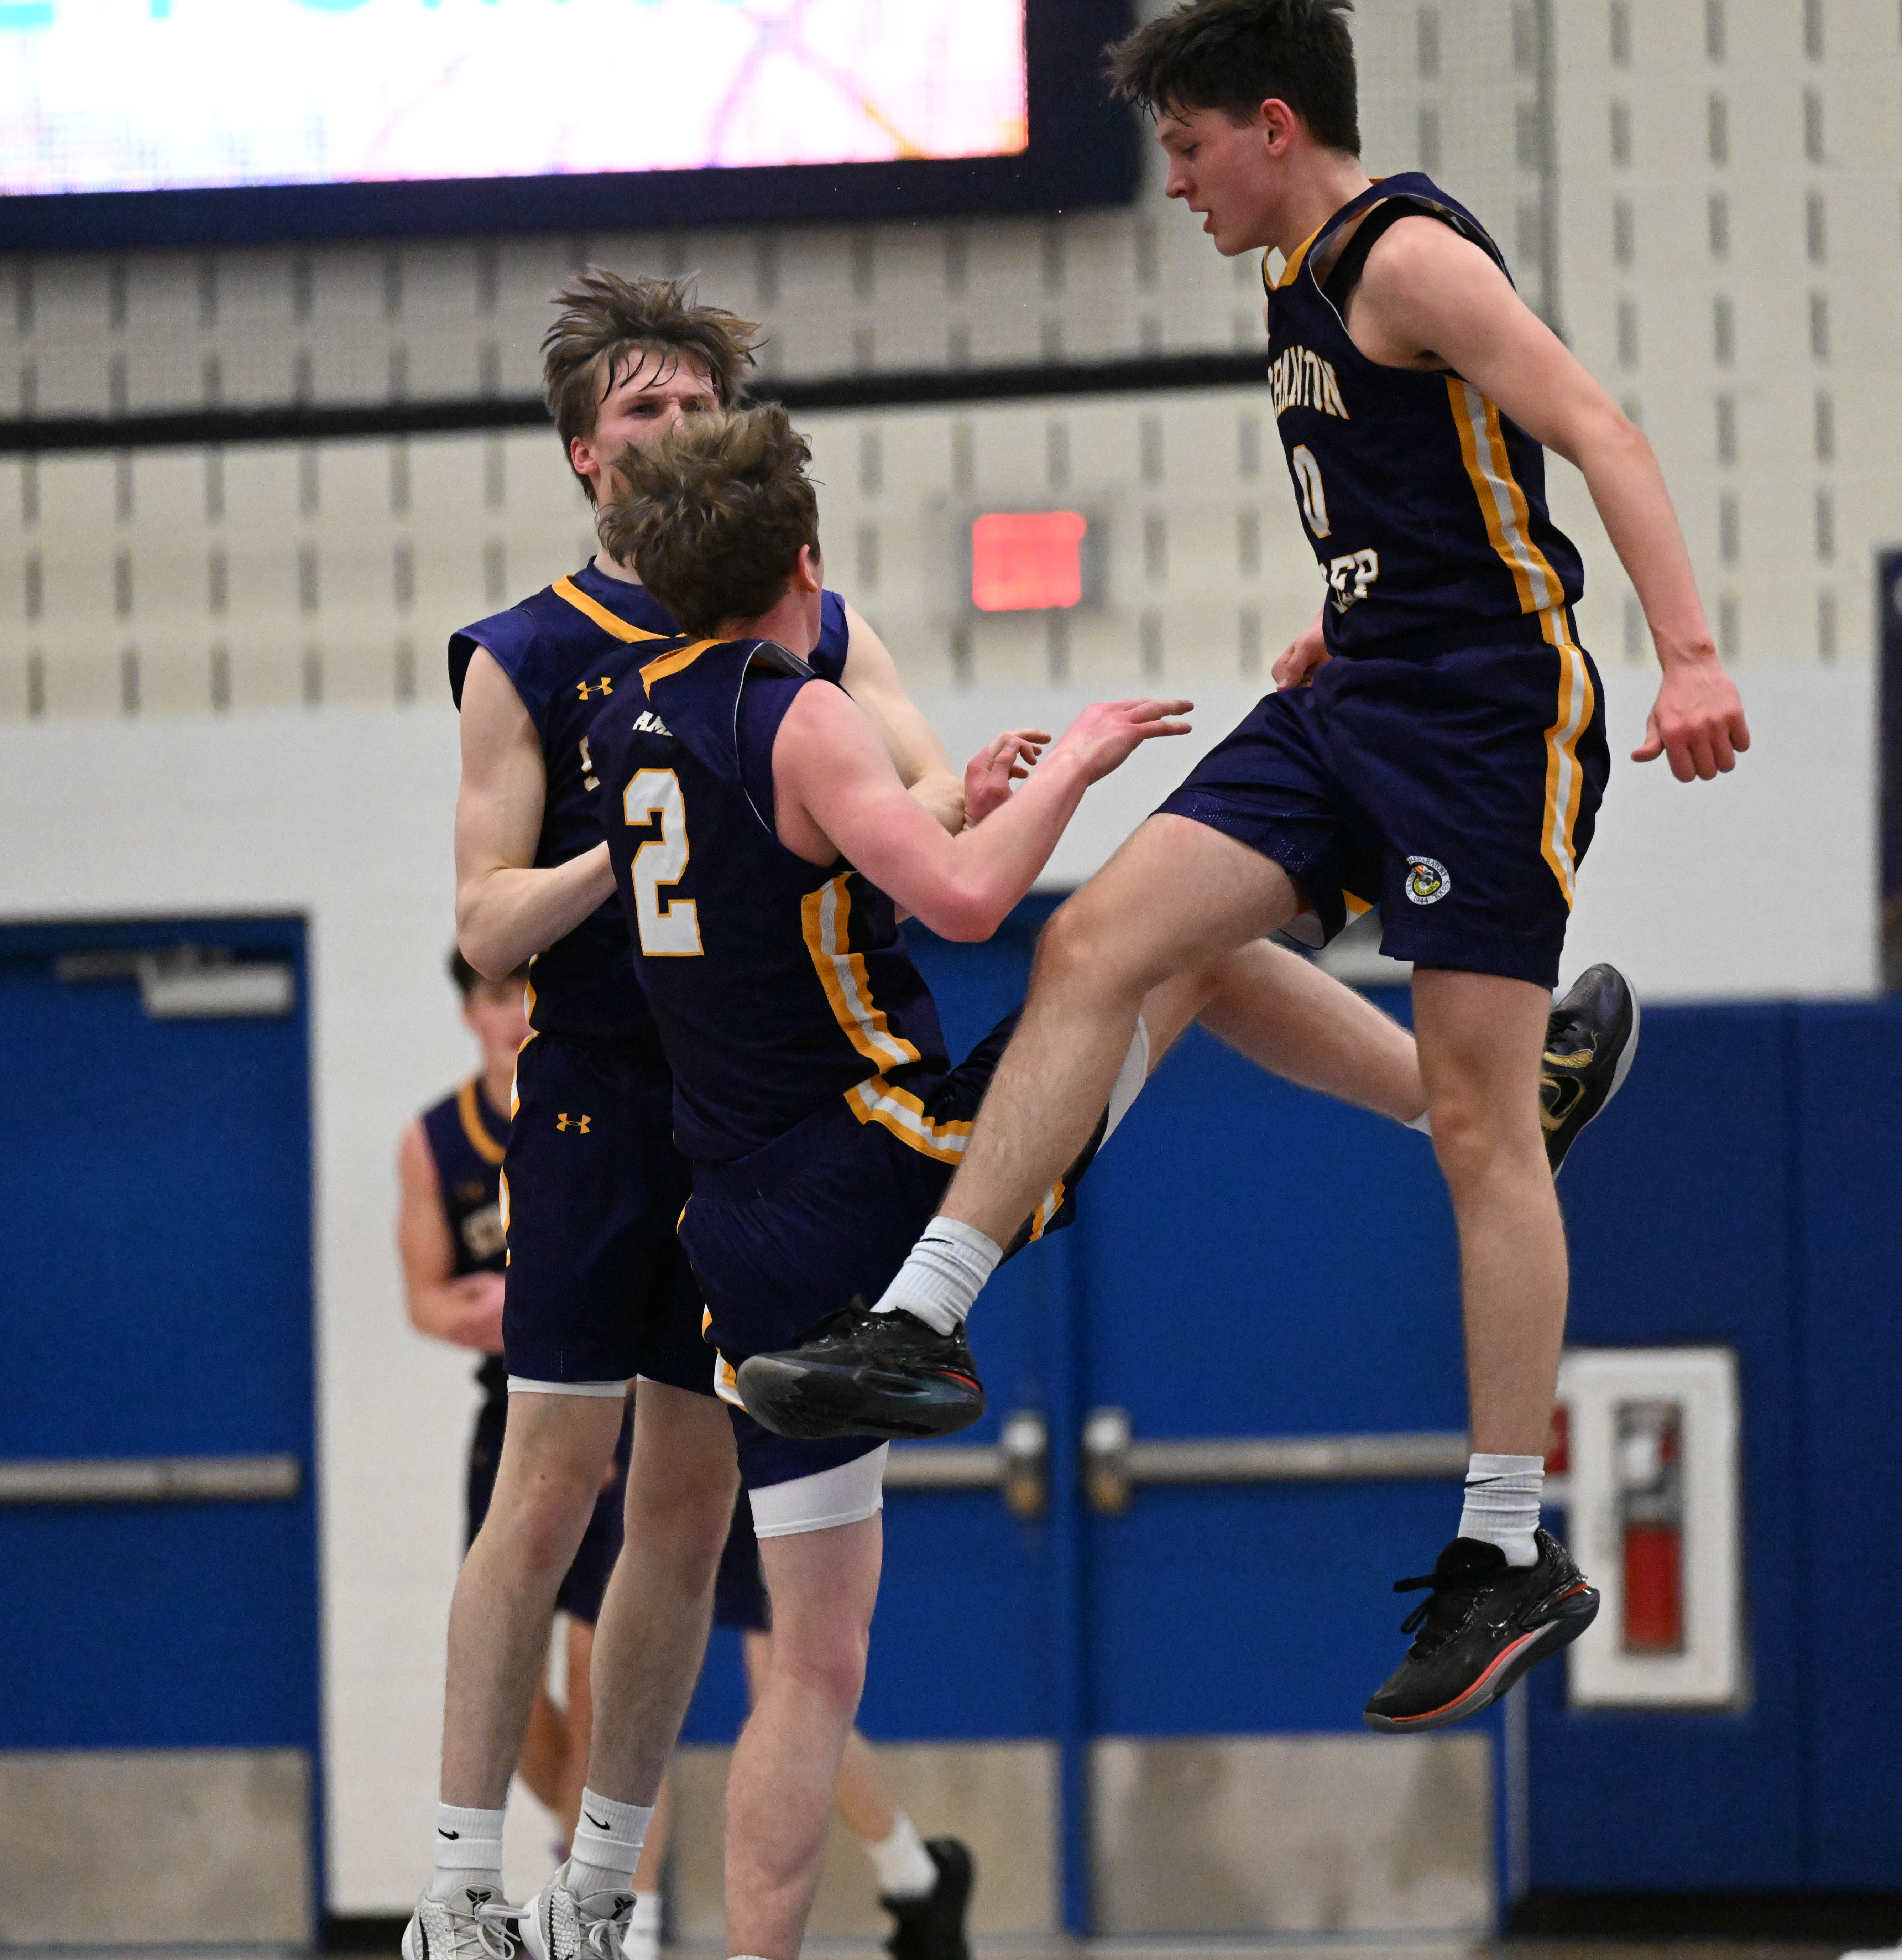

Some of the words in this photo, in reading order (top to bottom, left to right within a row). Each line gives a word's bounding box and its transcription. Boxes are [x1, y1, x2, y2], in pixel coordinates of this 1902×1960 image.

[1292, 444, 1332, 539] 0
[1319, 547, 1379, 614] EP
[623, 767, 705, 957] 2
[1413, 896, 1428, 904] 1944
